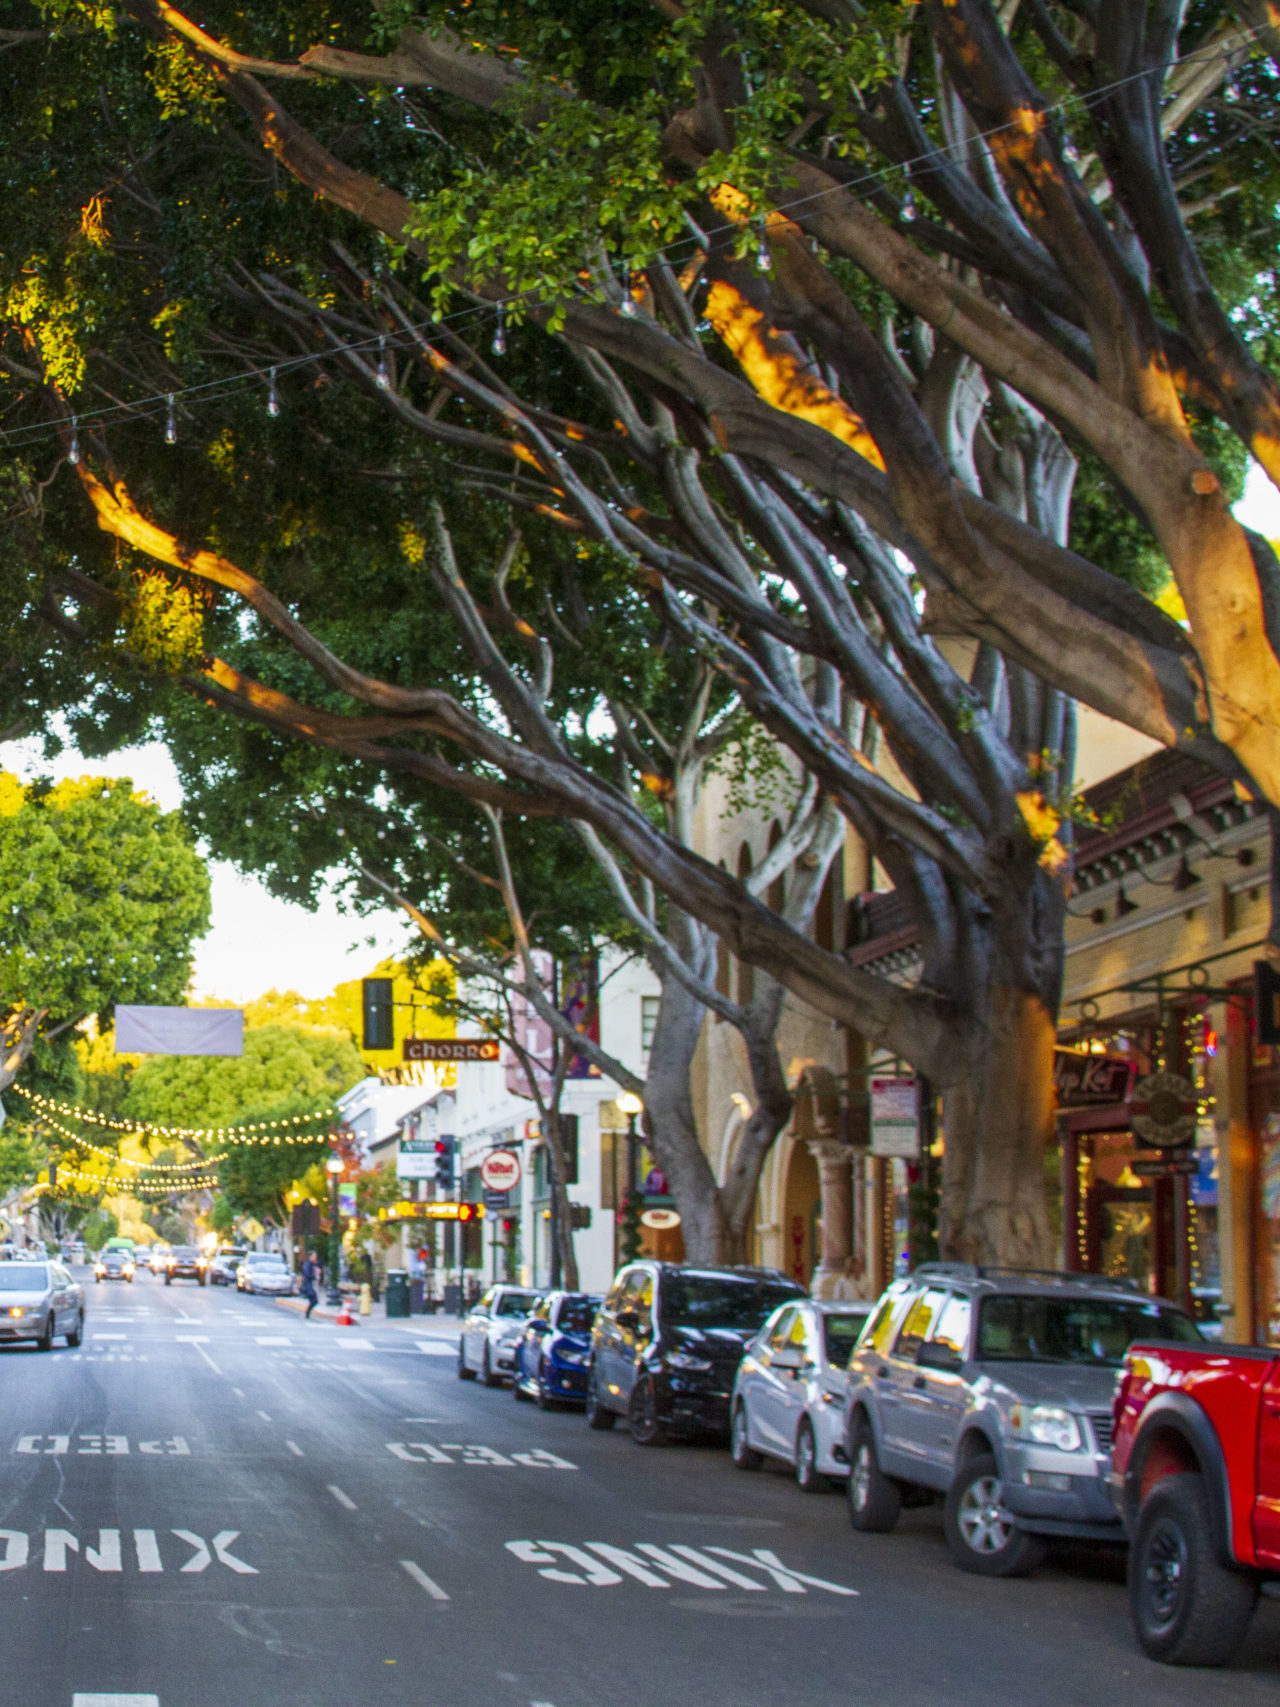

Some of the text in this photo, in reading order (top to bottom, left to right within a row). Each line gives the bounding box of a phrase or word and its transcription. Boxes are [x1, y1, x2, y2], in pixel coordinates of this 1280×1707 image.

[14, 1434, 193, 1456] PED
[384, 1441, 580, 1471] PED
[504, 1539, 860, 1596] XING
